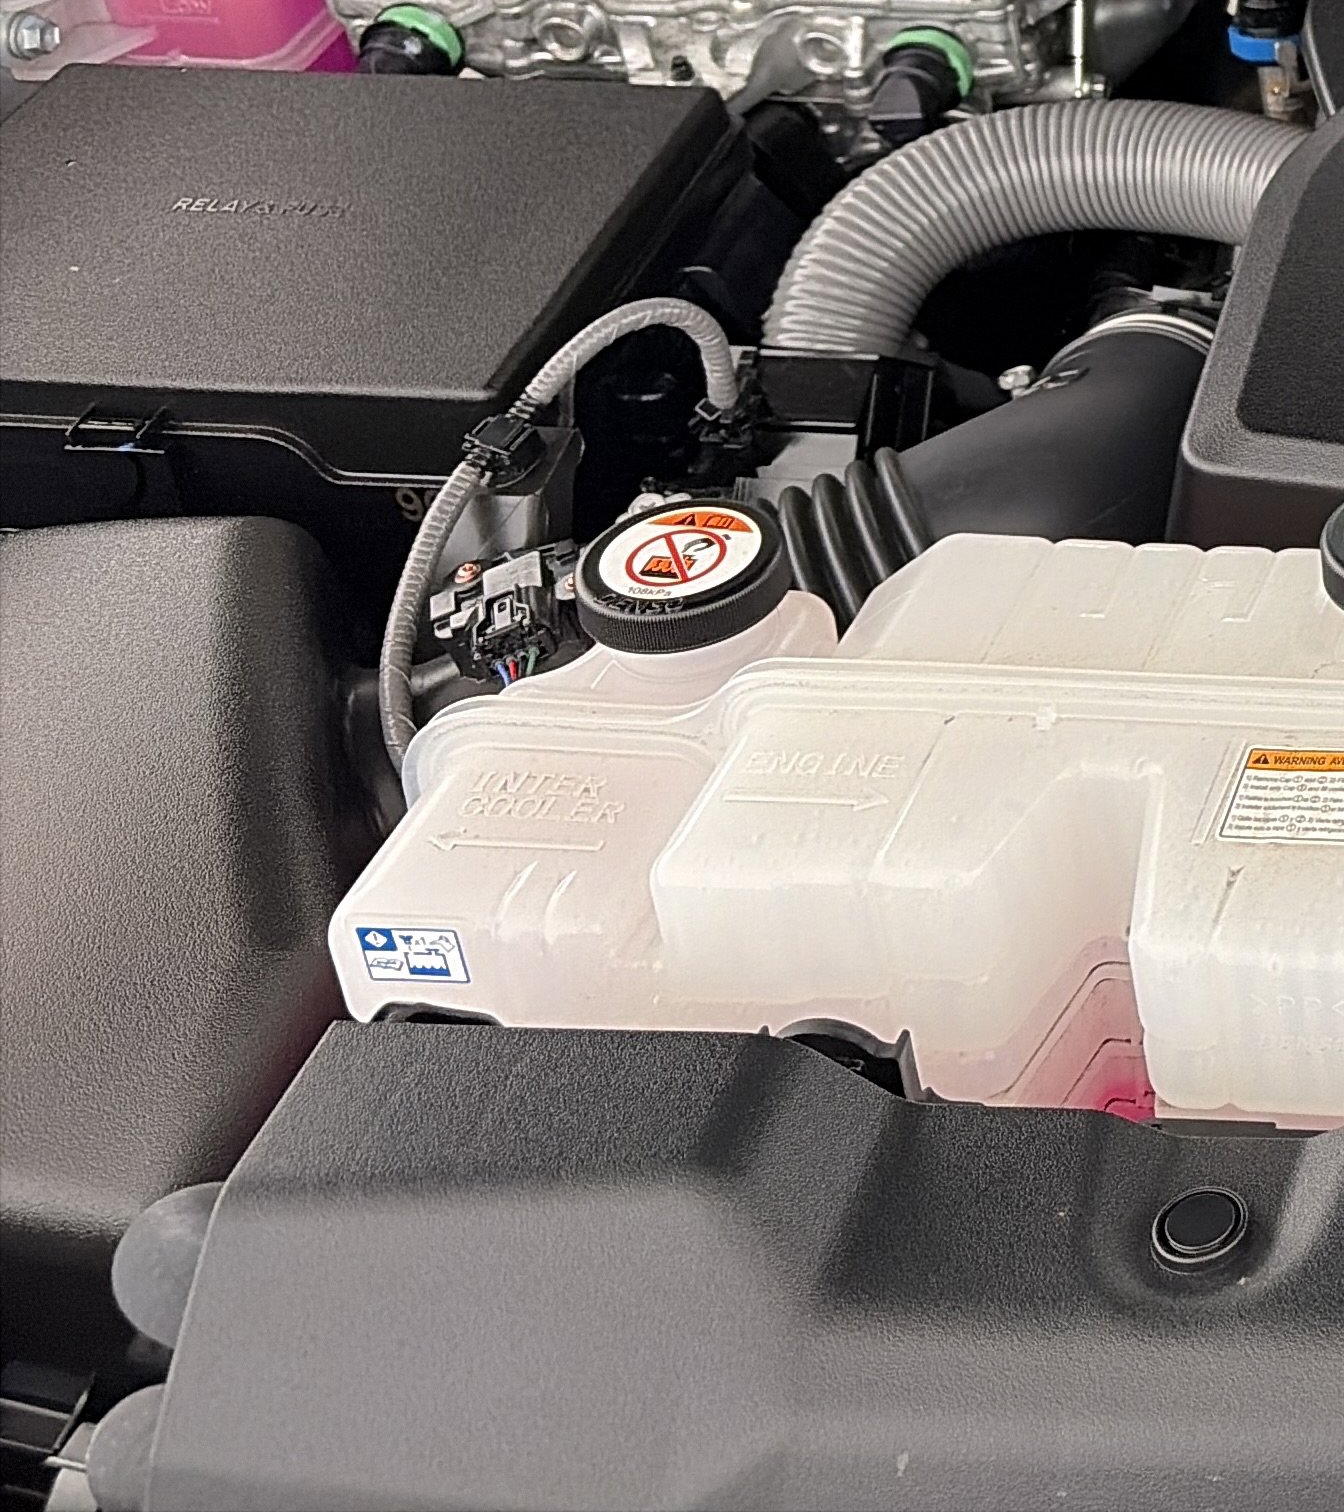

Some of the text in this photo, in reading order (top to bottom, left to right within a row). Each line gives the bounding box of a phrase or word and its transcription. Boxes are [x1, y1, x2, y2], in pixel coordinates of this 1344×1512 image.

[742, 750, 907, 780] ENGINE
[1273, 754, 1326, 767] WARNING
[471, 770, 608, 799] INTER
[456, 796, 627, 825] COOLER
